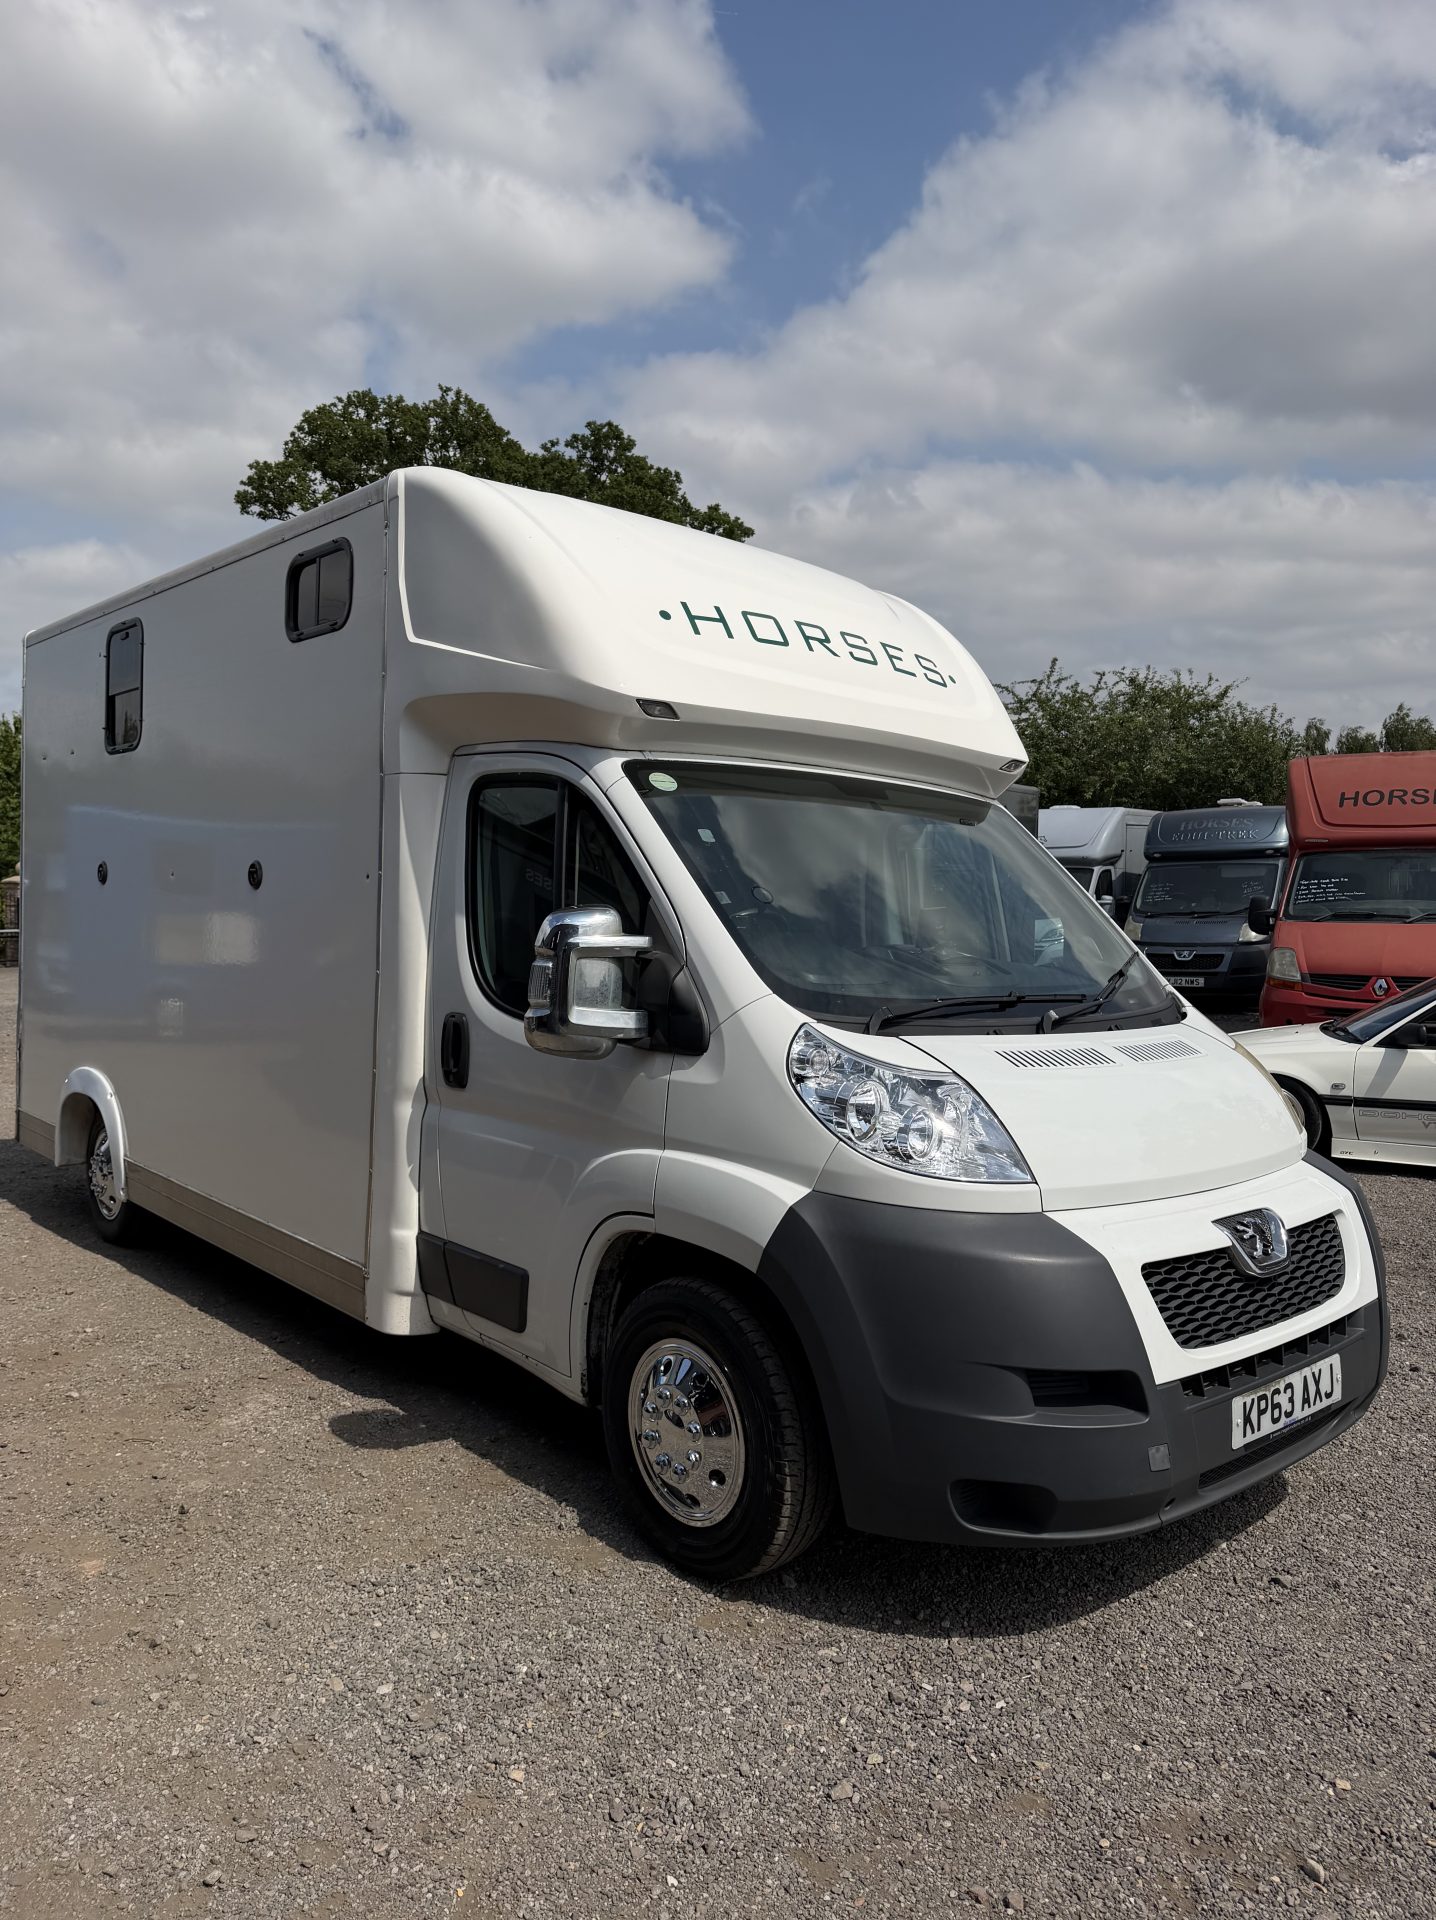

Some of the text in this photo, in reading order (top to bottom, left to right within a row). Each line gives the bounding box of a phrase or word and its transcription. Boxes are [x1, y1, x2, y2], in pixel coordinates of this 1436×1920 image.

[1338, 788, 1436, 808] HORS
[1180, 817, 1255, 831] HORSES
[1184, 978, 1200, 986] NWS
[1242, 1382, 1295, 1438] KP63
[1301, 1363, 1334, 1412] AXJ
